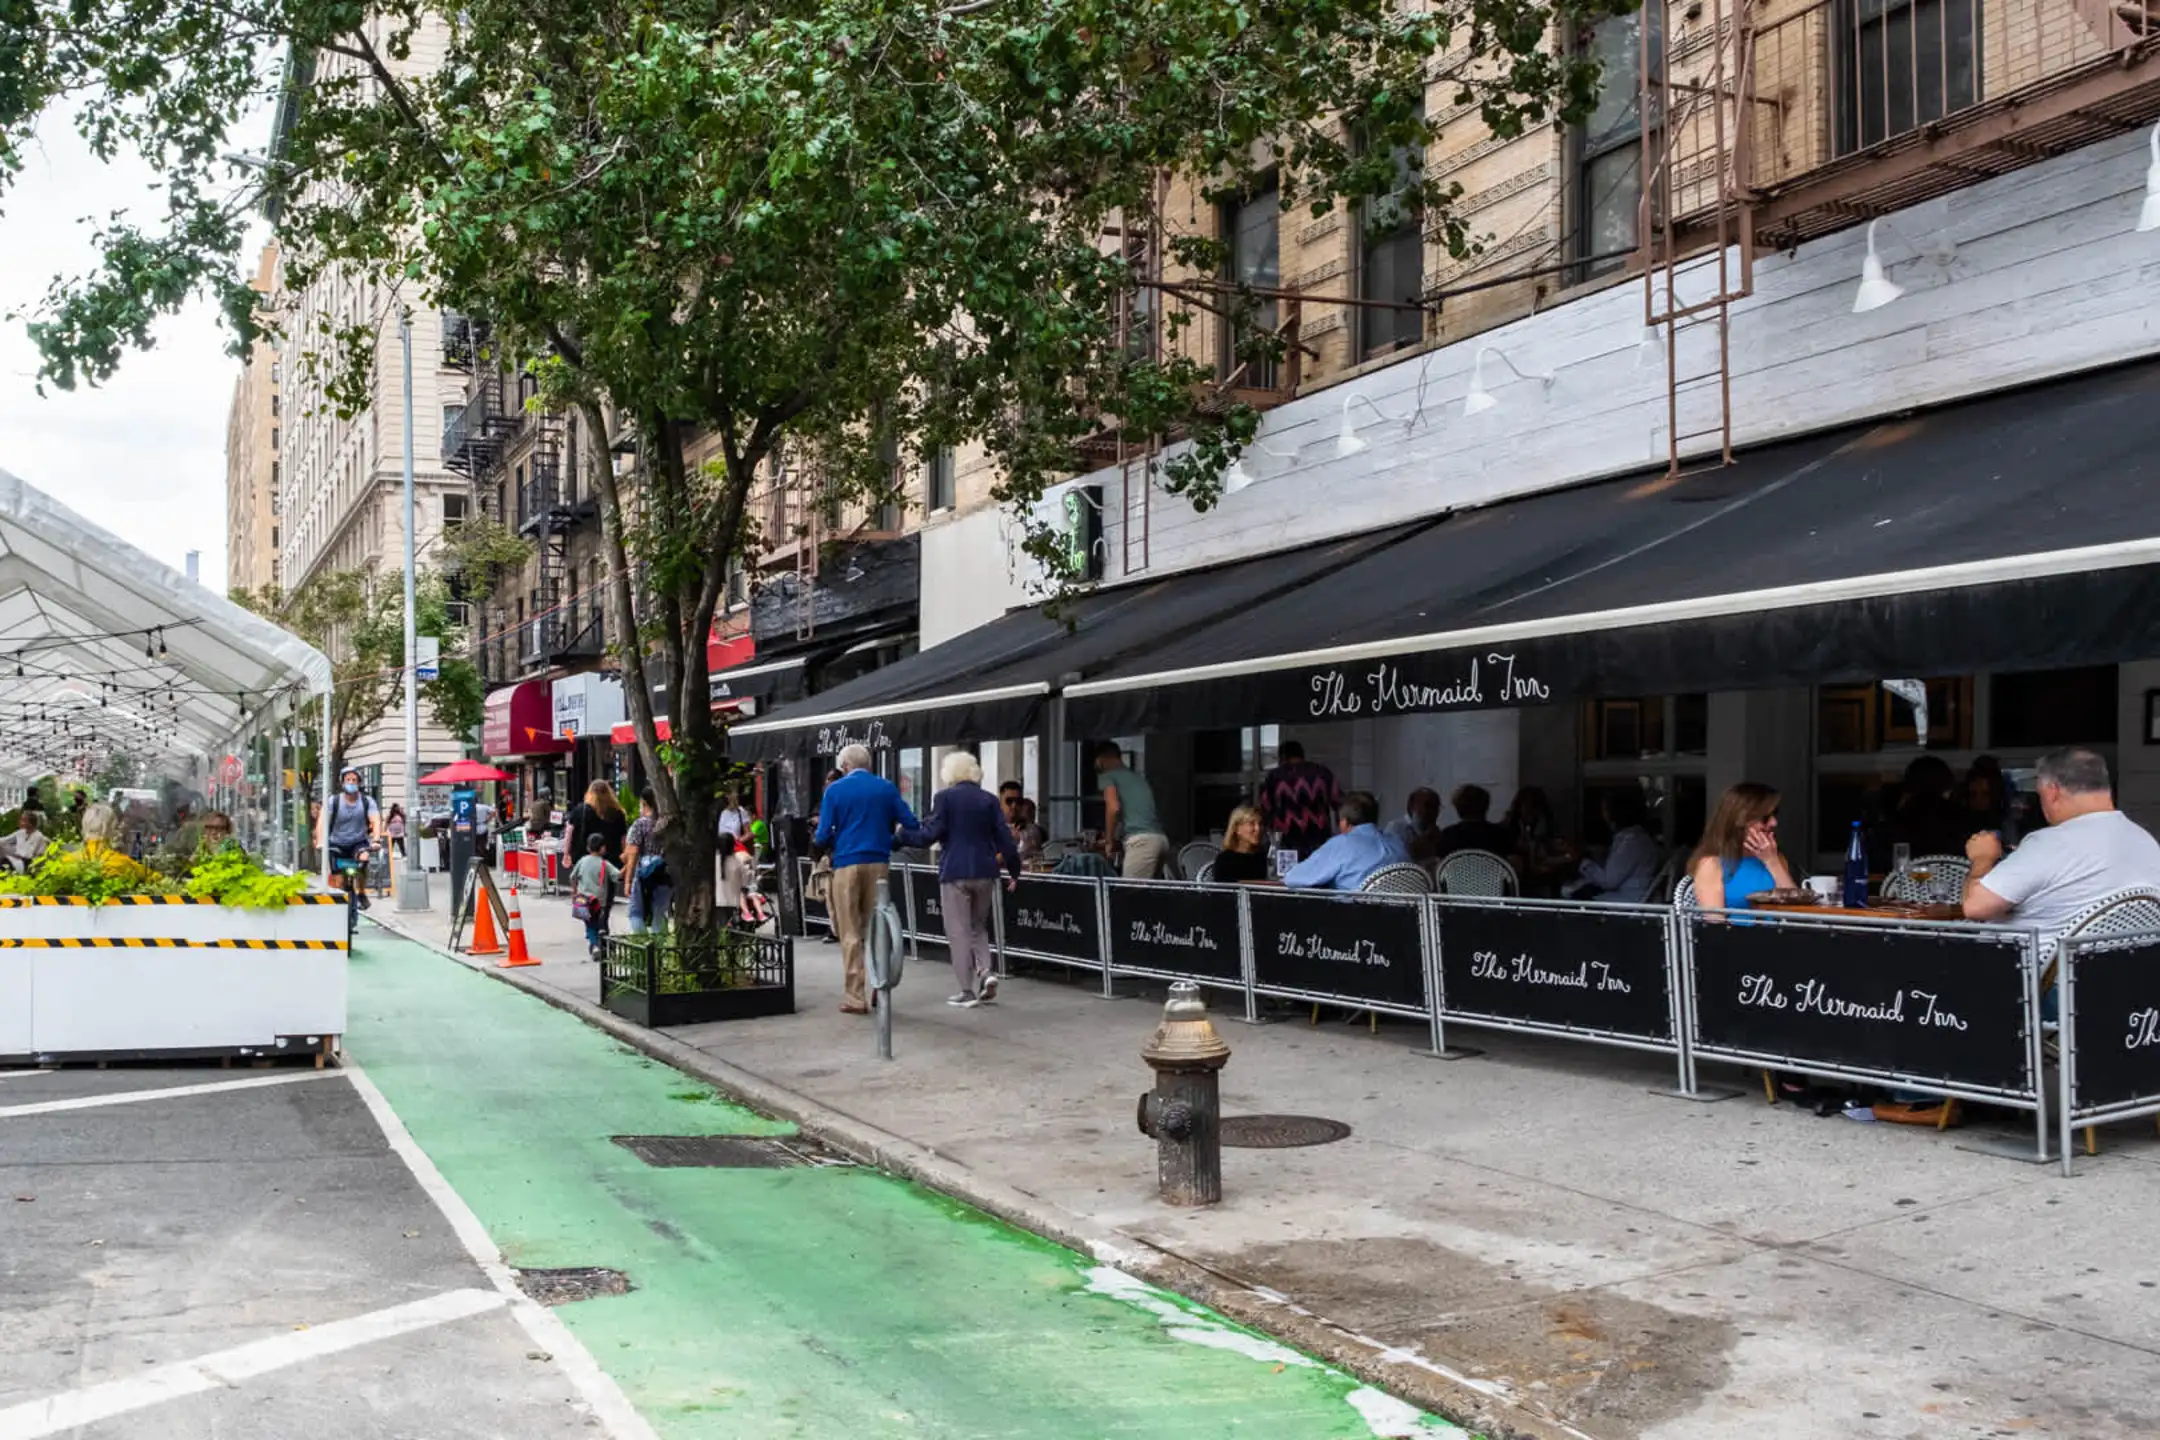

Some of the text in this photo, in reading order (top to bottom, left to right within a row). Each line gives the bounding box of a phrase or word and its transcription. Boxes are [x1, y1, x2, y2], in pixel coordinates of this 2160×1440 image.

[1310, 653, 1549, 715] The Mermaid Inn
[1130, 920, 1217, 950] The Mermaid Inn
[1278, 931, 1390, 968] The Mermaid Inn
[1471, 951, 1631, 993] The Mermaid Inn
[1738, 974, 1968, 1031] The Mermaid Inn
[2125, 1007, 2160, 1049] Th
